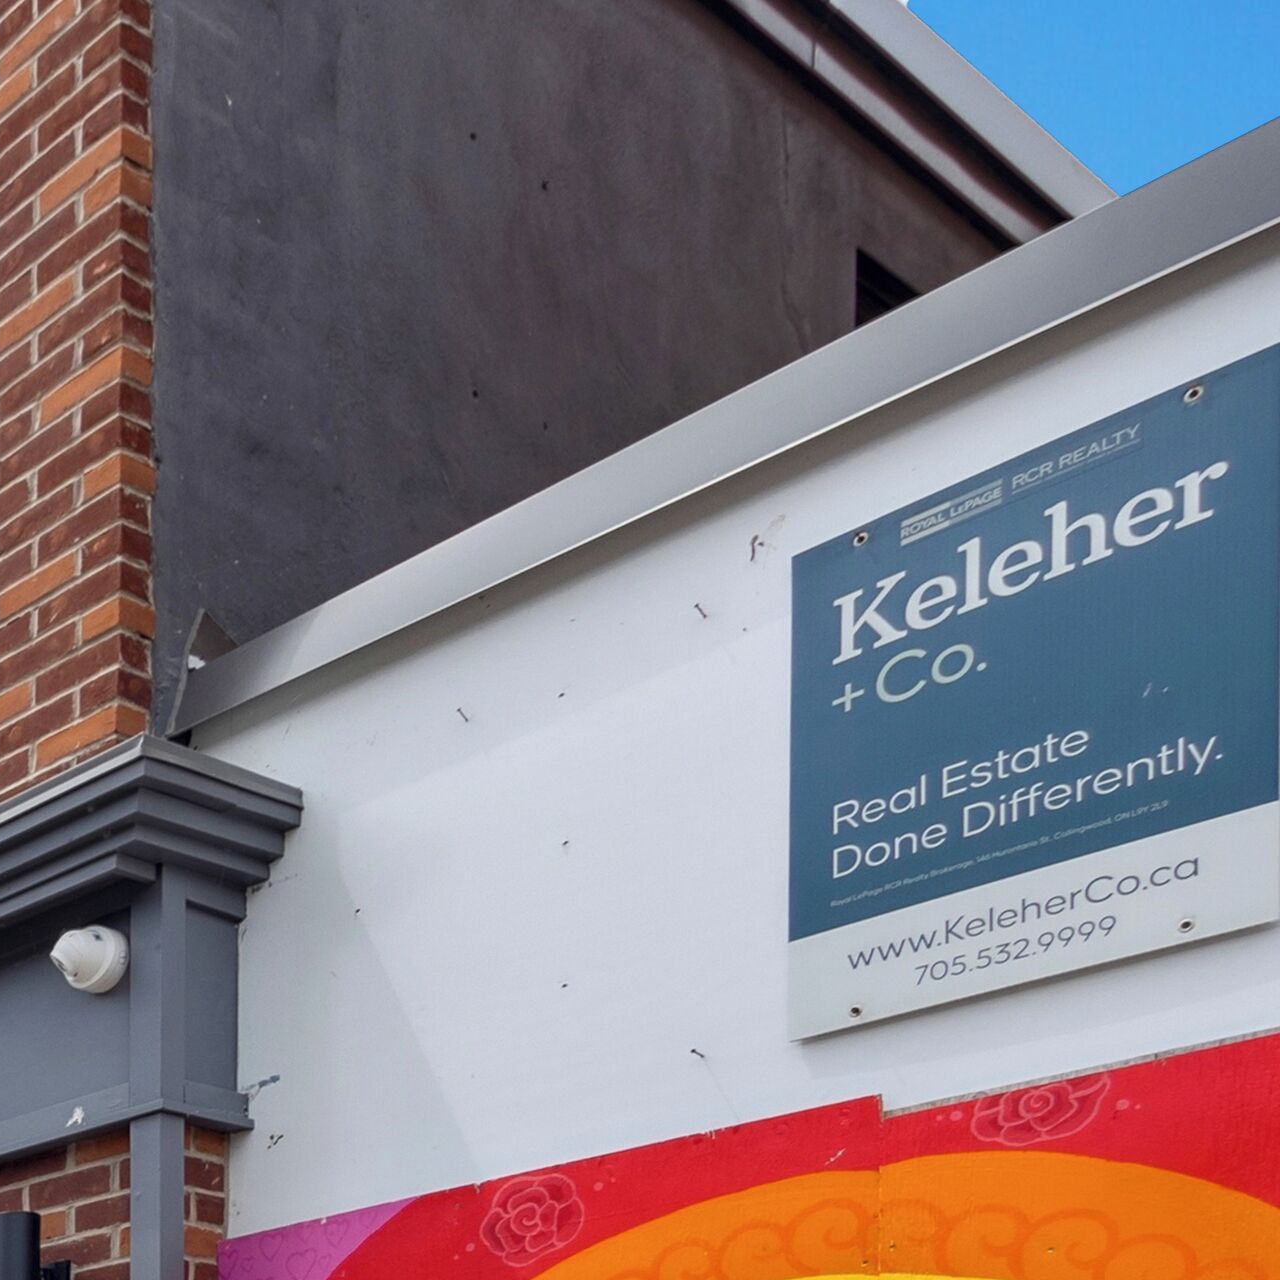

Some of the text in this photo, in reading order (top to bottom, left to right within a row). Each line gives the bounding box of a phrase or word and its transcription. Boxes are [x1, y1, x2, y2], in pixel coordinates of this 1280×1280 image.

[900, 513, 945, 540] ROYAL
[1012, 460, 1054, 490] RCR
[1058, 423, 1141, 470] REALTY
[832, 461, 1229, 665] Keleher
[832, 729, 1090, 836] Real Estate
[832, 735, 1224, 880] Done Differently.
[847, 856, 1200, 970] www.KeleherCo.ca
[914, 915, 1117, 986] 705.532.9999
